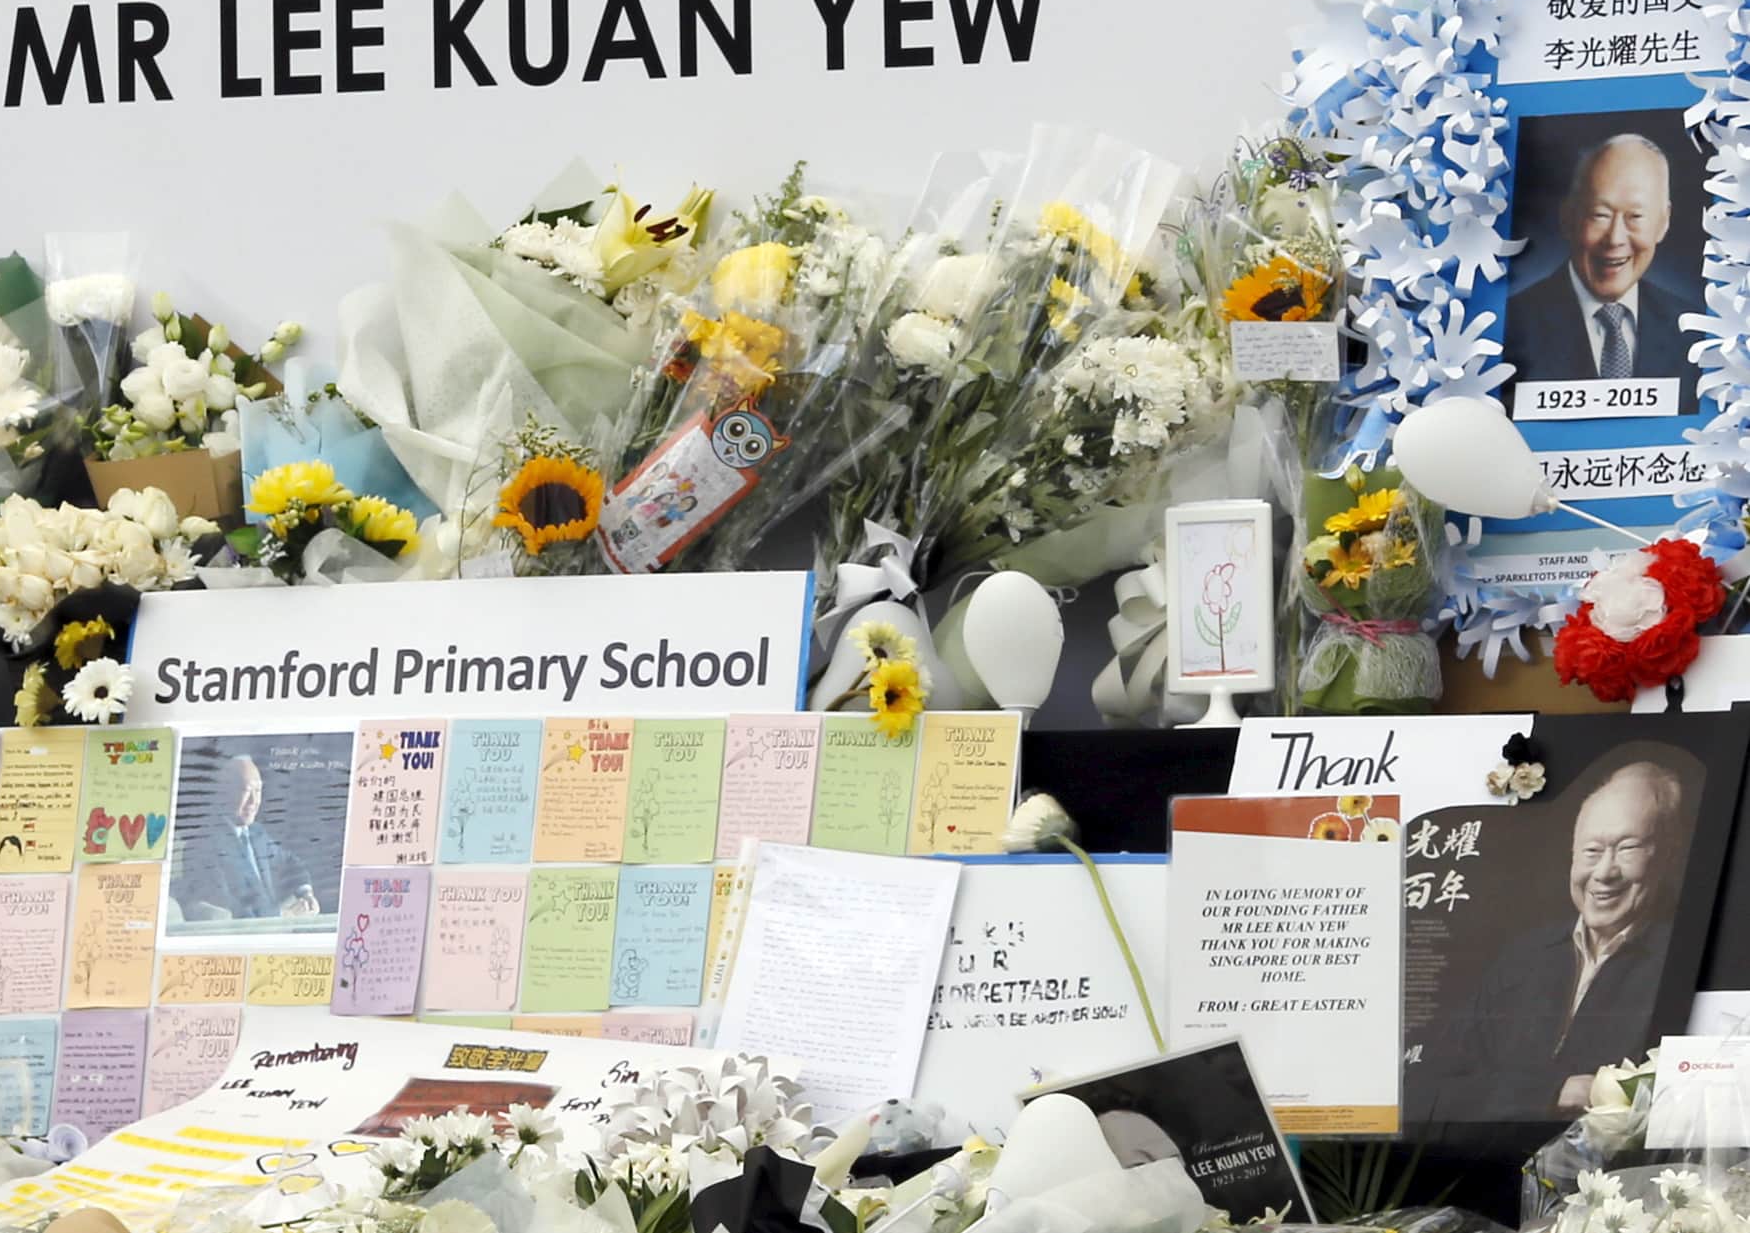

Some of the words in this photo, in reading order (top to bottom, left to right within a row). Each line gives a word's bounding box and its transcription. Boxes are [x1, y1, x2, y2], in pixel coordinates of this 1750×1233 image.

[4, 2, 174, 108] MR
[1544, 30, 1701, 70] 李光耀先生
[1536, 388, 1586, 410] 1923
[1606, 388, 1658, 408] 2015
[1539, 556, 1565, 566] STAFF
[1567, 556, 1588, 564] AND
[1495, 573, 1557, 583] SPARKLETOTS
[1559, 571, 1598, 580] PRESCH
[155, 647, 378, 704] Stamford
[394, 644, 587, 700] Primary
[600, 637, 768, 689] School
[400, 732, 440, 749] THANK
[473, 733, 520, 747] THANK
[588, 733, 630, 751] THANK
[654, 733, 704, 748] THANK
[771, 729, 816, 748] THANK
[826, 731, 876, 747] THANK
[946, 728, 995, 742] THANK
[480, 748, 512, 761] YOU
[664, 748, 696, 762] YOU
[774, 750, 810, 769] YOU!
[953, 744, 986, 757] YOU
[402, 752, 434, 770] YOU!
[592, 754, 624, 772] YOU!
[1270, 731, 1400, 791] Thank
[1405, 819, 1482, 860] 光耀
[439, 888, 486, 902] THANK
[491, 887, 522, 902] YOU
[573, 882, 614, 901] THANK
[634, 882, 698, 895] THANK
[1206, 890, 1222, 901] IN
[1225, 889, 1277, 900] LOVING
[1281, 888, 1343, 900] MEMORY
[1346, 888, 1366, 899] OF
[1402, 869, 1470, 912] 百年
[641, 895, 690, 907] YOU!
[577, 904, 609, 922] YOU!
[1202, 906, 1231, 917] OUR
[1234, 905, 1308, 916] FOUNDING
[1313, 904, 1369, 915] FATHER
[1221, 922, 1242, 933] MR
[1246, 922, 1273, 933] LEE
[1276, 921, 1314, 932] KUAN
[1319, 921, 1348, 932] YEW
[1201, 939, 1246, 950] THANK
[1251, 938, 1278, 950] YOU
[1283, 938, 1310, 949] FOR
[1313, 937, 1370, 949] MAKING
[200, 956, 242, 975] THANK
[291, 956, 331, 975] THANK
[1210, 955, 1289, 967] SINGAPORE
[1292, 954, 1321, 966] OUR
[1325, 954, 1361, 965] BEST
[1261, 971, 1306, 982] HOME.
[203, 978, 235, 997] YOU!
[293, 977, 325, 996] YOU!
[932, 977, 1090, 1004] FORGETTABLE
[1198, 1001, 1239, 1012] FROM
[1251, 999, 1299, 1012] GREAT
[1301, 999, 1367, 1011] EASTERN
[196, 1019, 235, 1037] THANK
[199, 1039, 229, 1059] YOU!
[1191, 1159, 1213, 1177] LEE
[1216, 1150, 1249, 1172] KUAN
[1248, 1144, 1277, 1163] YEW
